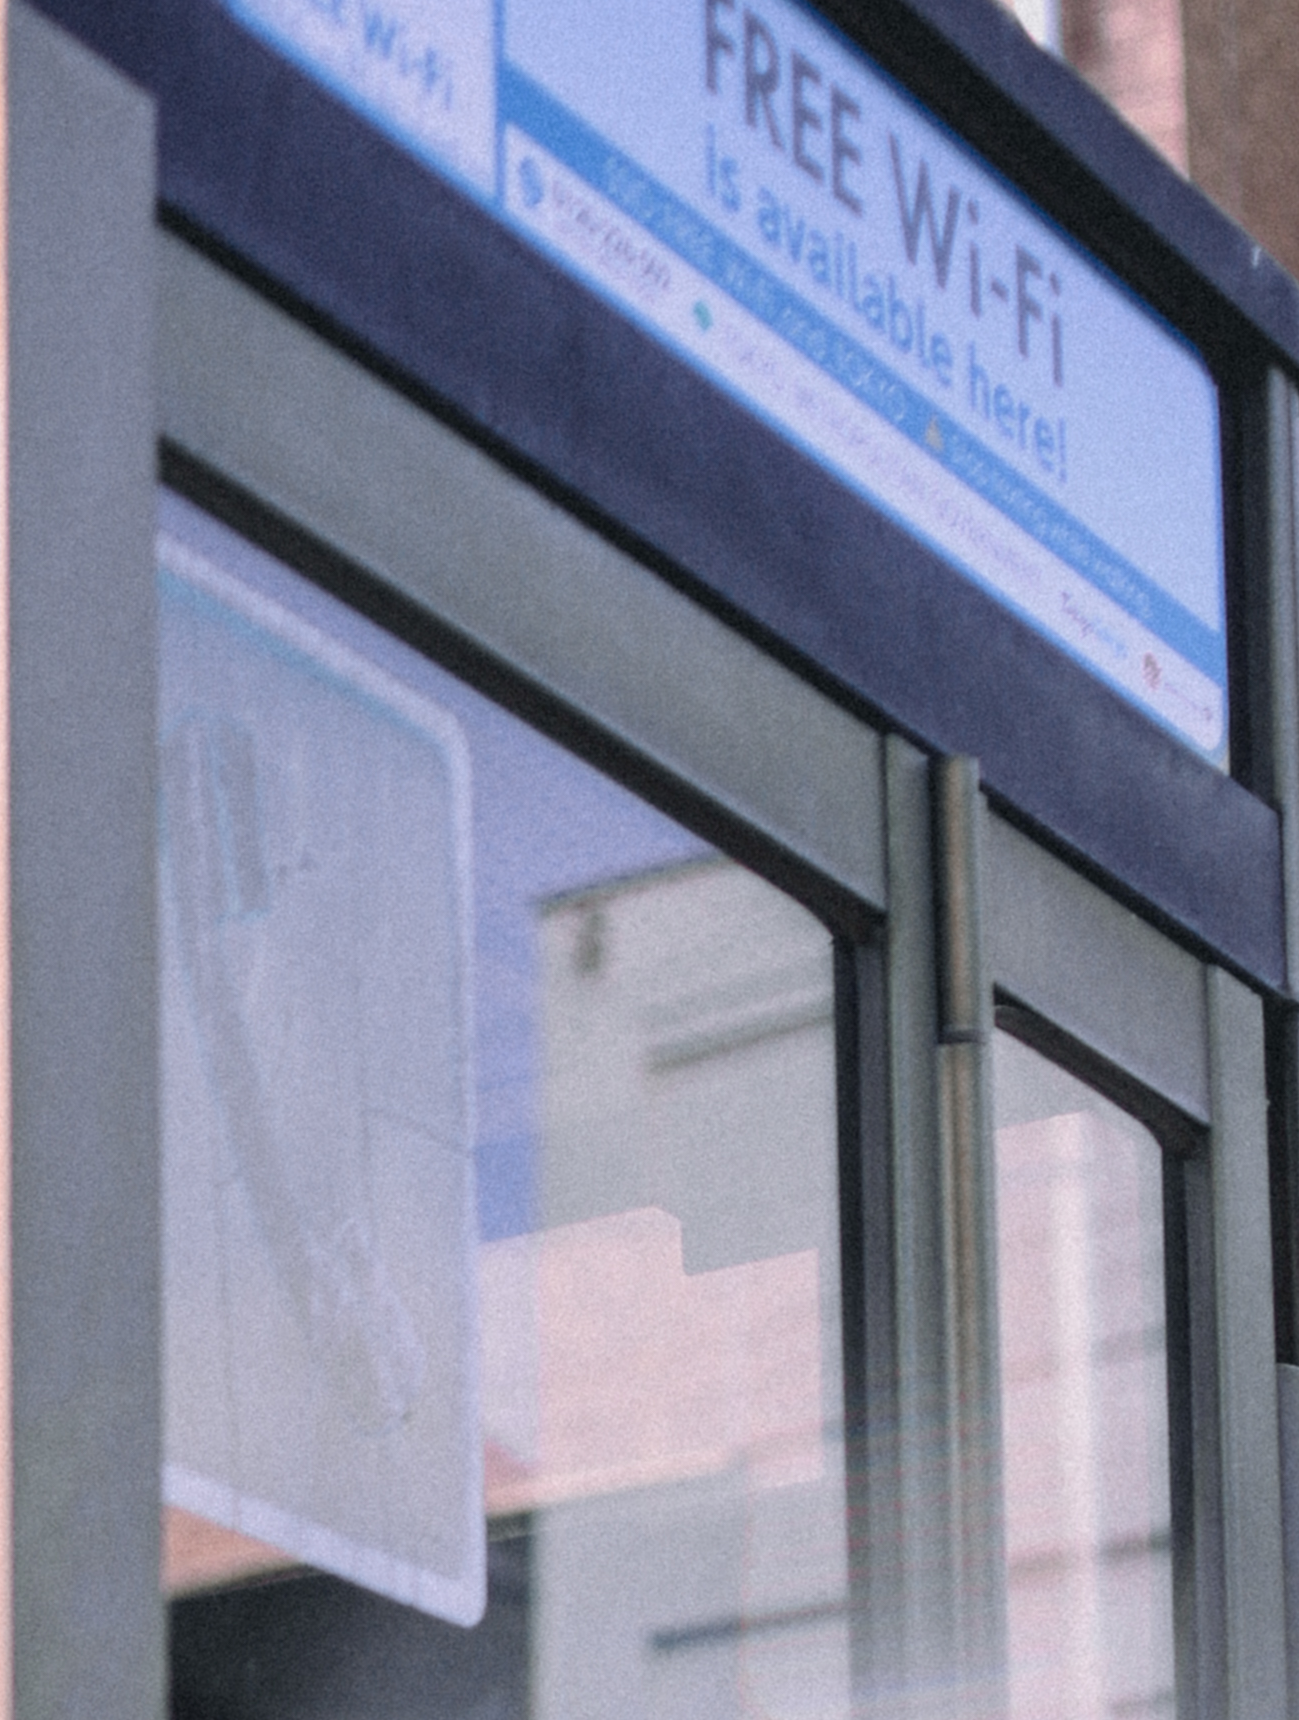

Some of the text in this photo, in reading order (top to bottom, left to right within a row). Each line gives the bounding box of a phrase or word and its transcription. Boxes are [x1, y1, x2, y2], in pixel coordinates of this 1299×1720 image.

[702, 0, 865, 220] FREE
[888, 130, 1064, 390] Wi-Fi
[756, 186, 954, 389] available
[968, 340, 1067, 485] here!
